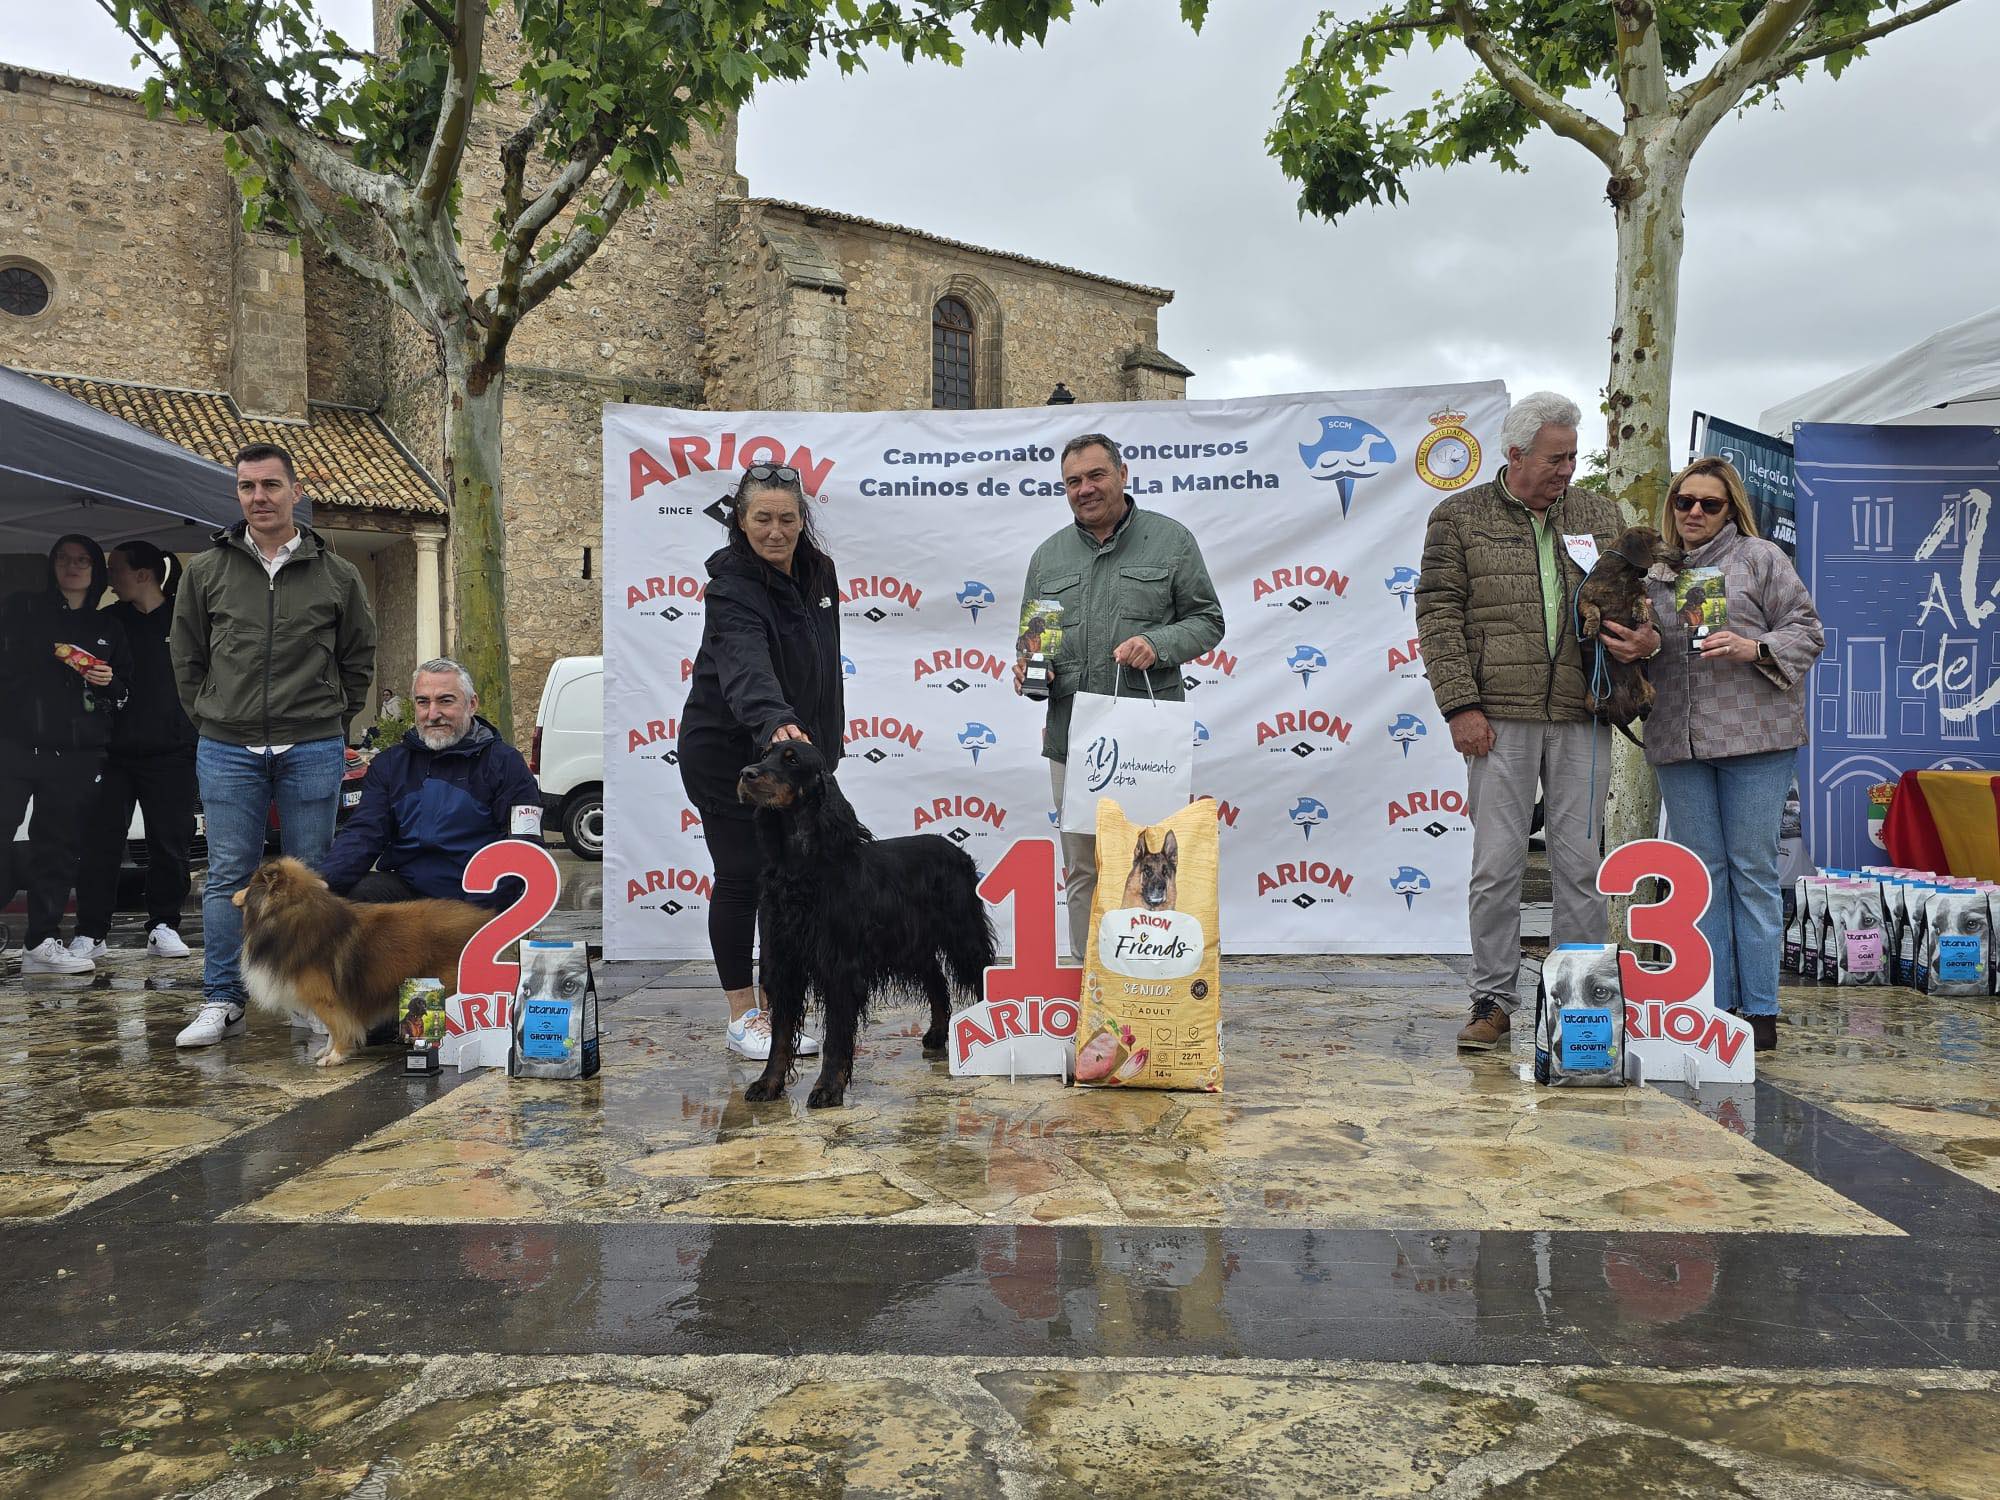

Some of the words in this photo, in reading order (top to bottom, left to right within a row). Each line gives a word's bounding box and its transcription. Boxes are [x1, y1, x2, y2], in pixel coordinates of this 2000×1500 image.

[1328, 421, 1352, 429] SCCM
[883, 444, 1055, 467] Campeonato
[1419, 447, 1427, 466] REAL
[1425, 429, 1462, 446] SOCIEDAD
[1464, 435, 1478, 463] CANINA
[629, 432, 836, 501] ARION
[859, 476, 968, 497] Caninos
[977, 477, 1010, 496] de
[1172, 470, 1279, 492] Mancha
[658, 507, 693, 515] SINCE
[1773, 525, 1796, 544] JABA
[1253, 565, 1349, 602] ARION
[914, 648, 1006, 681] ARION
[628, 718, 680, 753] ARI
[1256, 709, 1353, 746] ARION
[914, 796, 1007, 830] ARION
[1258, 861, 1353, 896] ARION
[458, 840, 560, 995] 2
[977, 838, 1083, 1002] 1
[1130, 914, 1171, 931] ARION
[1597, 839, 1712, 1003] 3
[1115, 932, 1193, 958] Friends
[1846, 932, 1879, 940] titanium
[1941, 940, 1977, 948] titanium
[1123, 982, 1172, 996] SENIOR
[528, 1005, 568, 1015] titanium
[1138, 1007, 1171, 1015] ADULT
[1564, 1014, 1609, 1023] titanium
[530, 1033, 562, 1041] GROWTH
[954, 998, 1082, 1067] ARIO
[1625, 1001, 1749, 1068] RION
[1570, 1043, 1607, 1051] GROWTH
